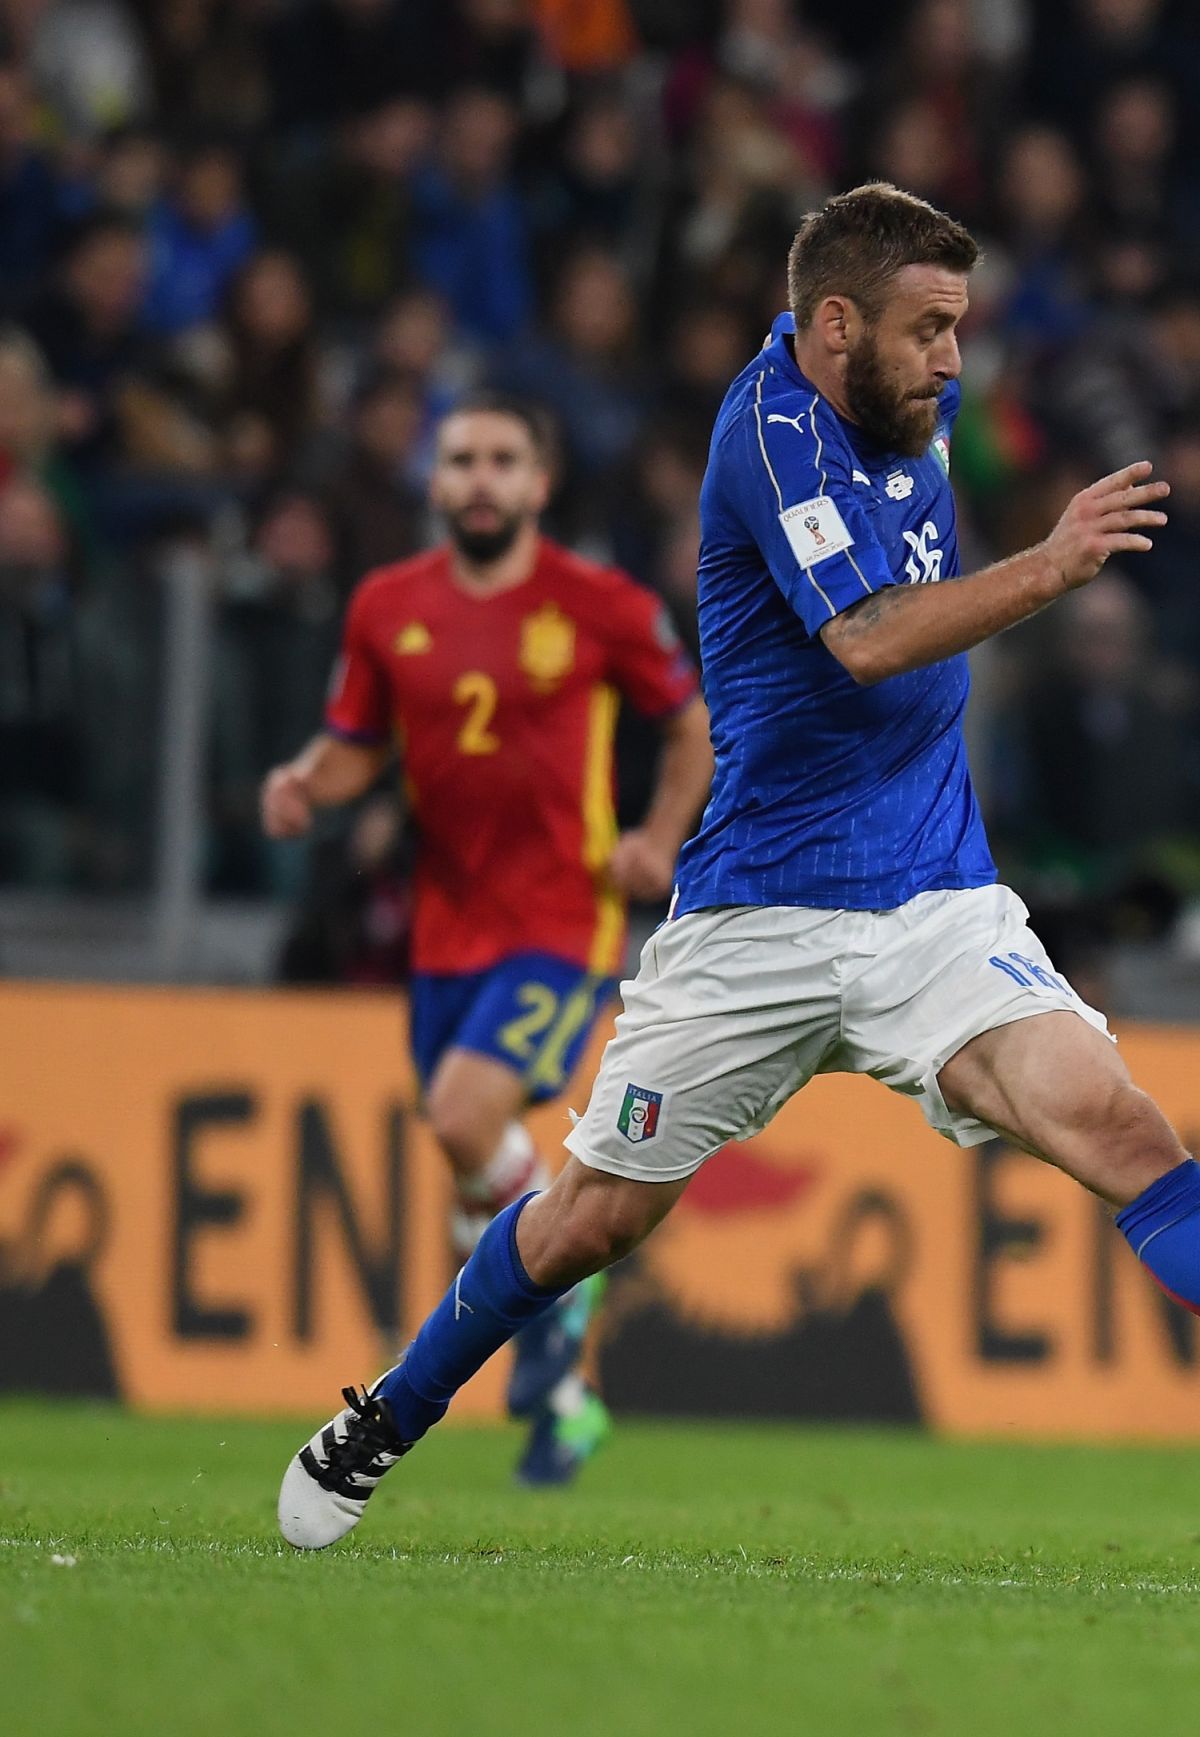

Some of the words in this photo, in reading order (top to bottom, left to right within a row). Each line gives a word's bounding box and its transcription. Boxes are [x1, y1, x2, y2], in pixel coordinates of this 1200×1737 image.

[783, 499, 829, 522] QUALIFIERS
[903, 520, 943, 584] 16
[454, 671, 499, 755] 2
[629, 1088, 657, 1102] ITALIA
[172, 1083, 410, 1345] EN
